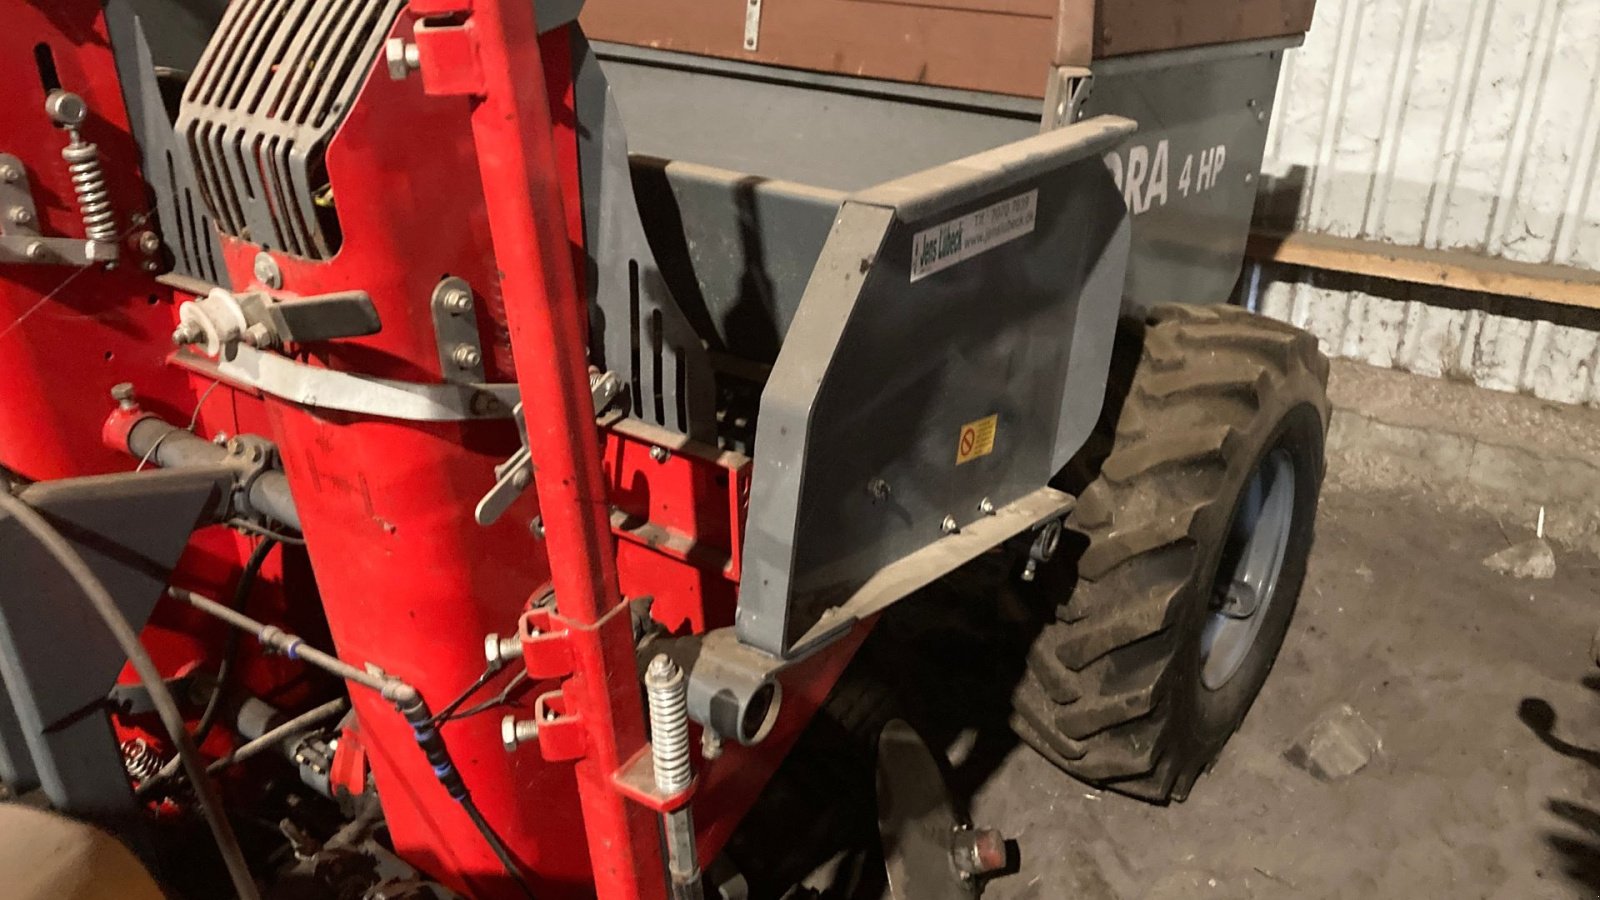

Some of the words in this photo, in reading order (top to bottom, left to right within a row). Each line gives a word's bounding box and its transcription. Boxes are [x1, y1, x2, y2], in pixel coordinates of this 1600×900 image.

[1178, 153, 1194, 198] 4
[1196, 144, 1226, 194] HP
[920, 233, 938, 267] Jens
